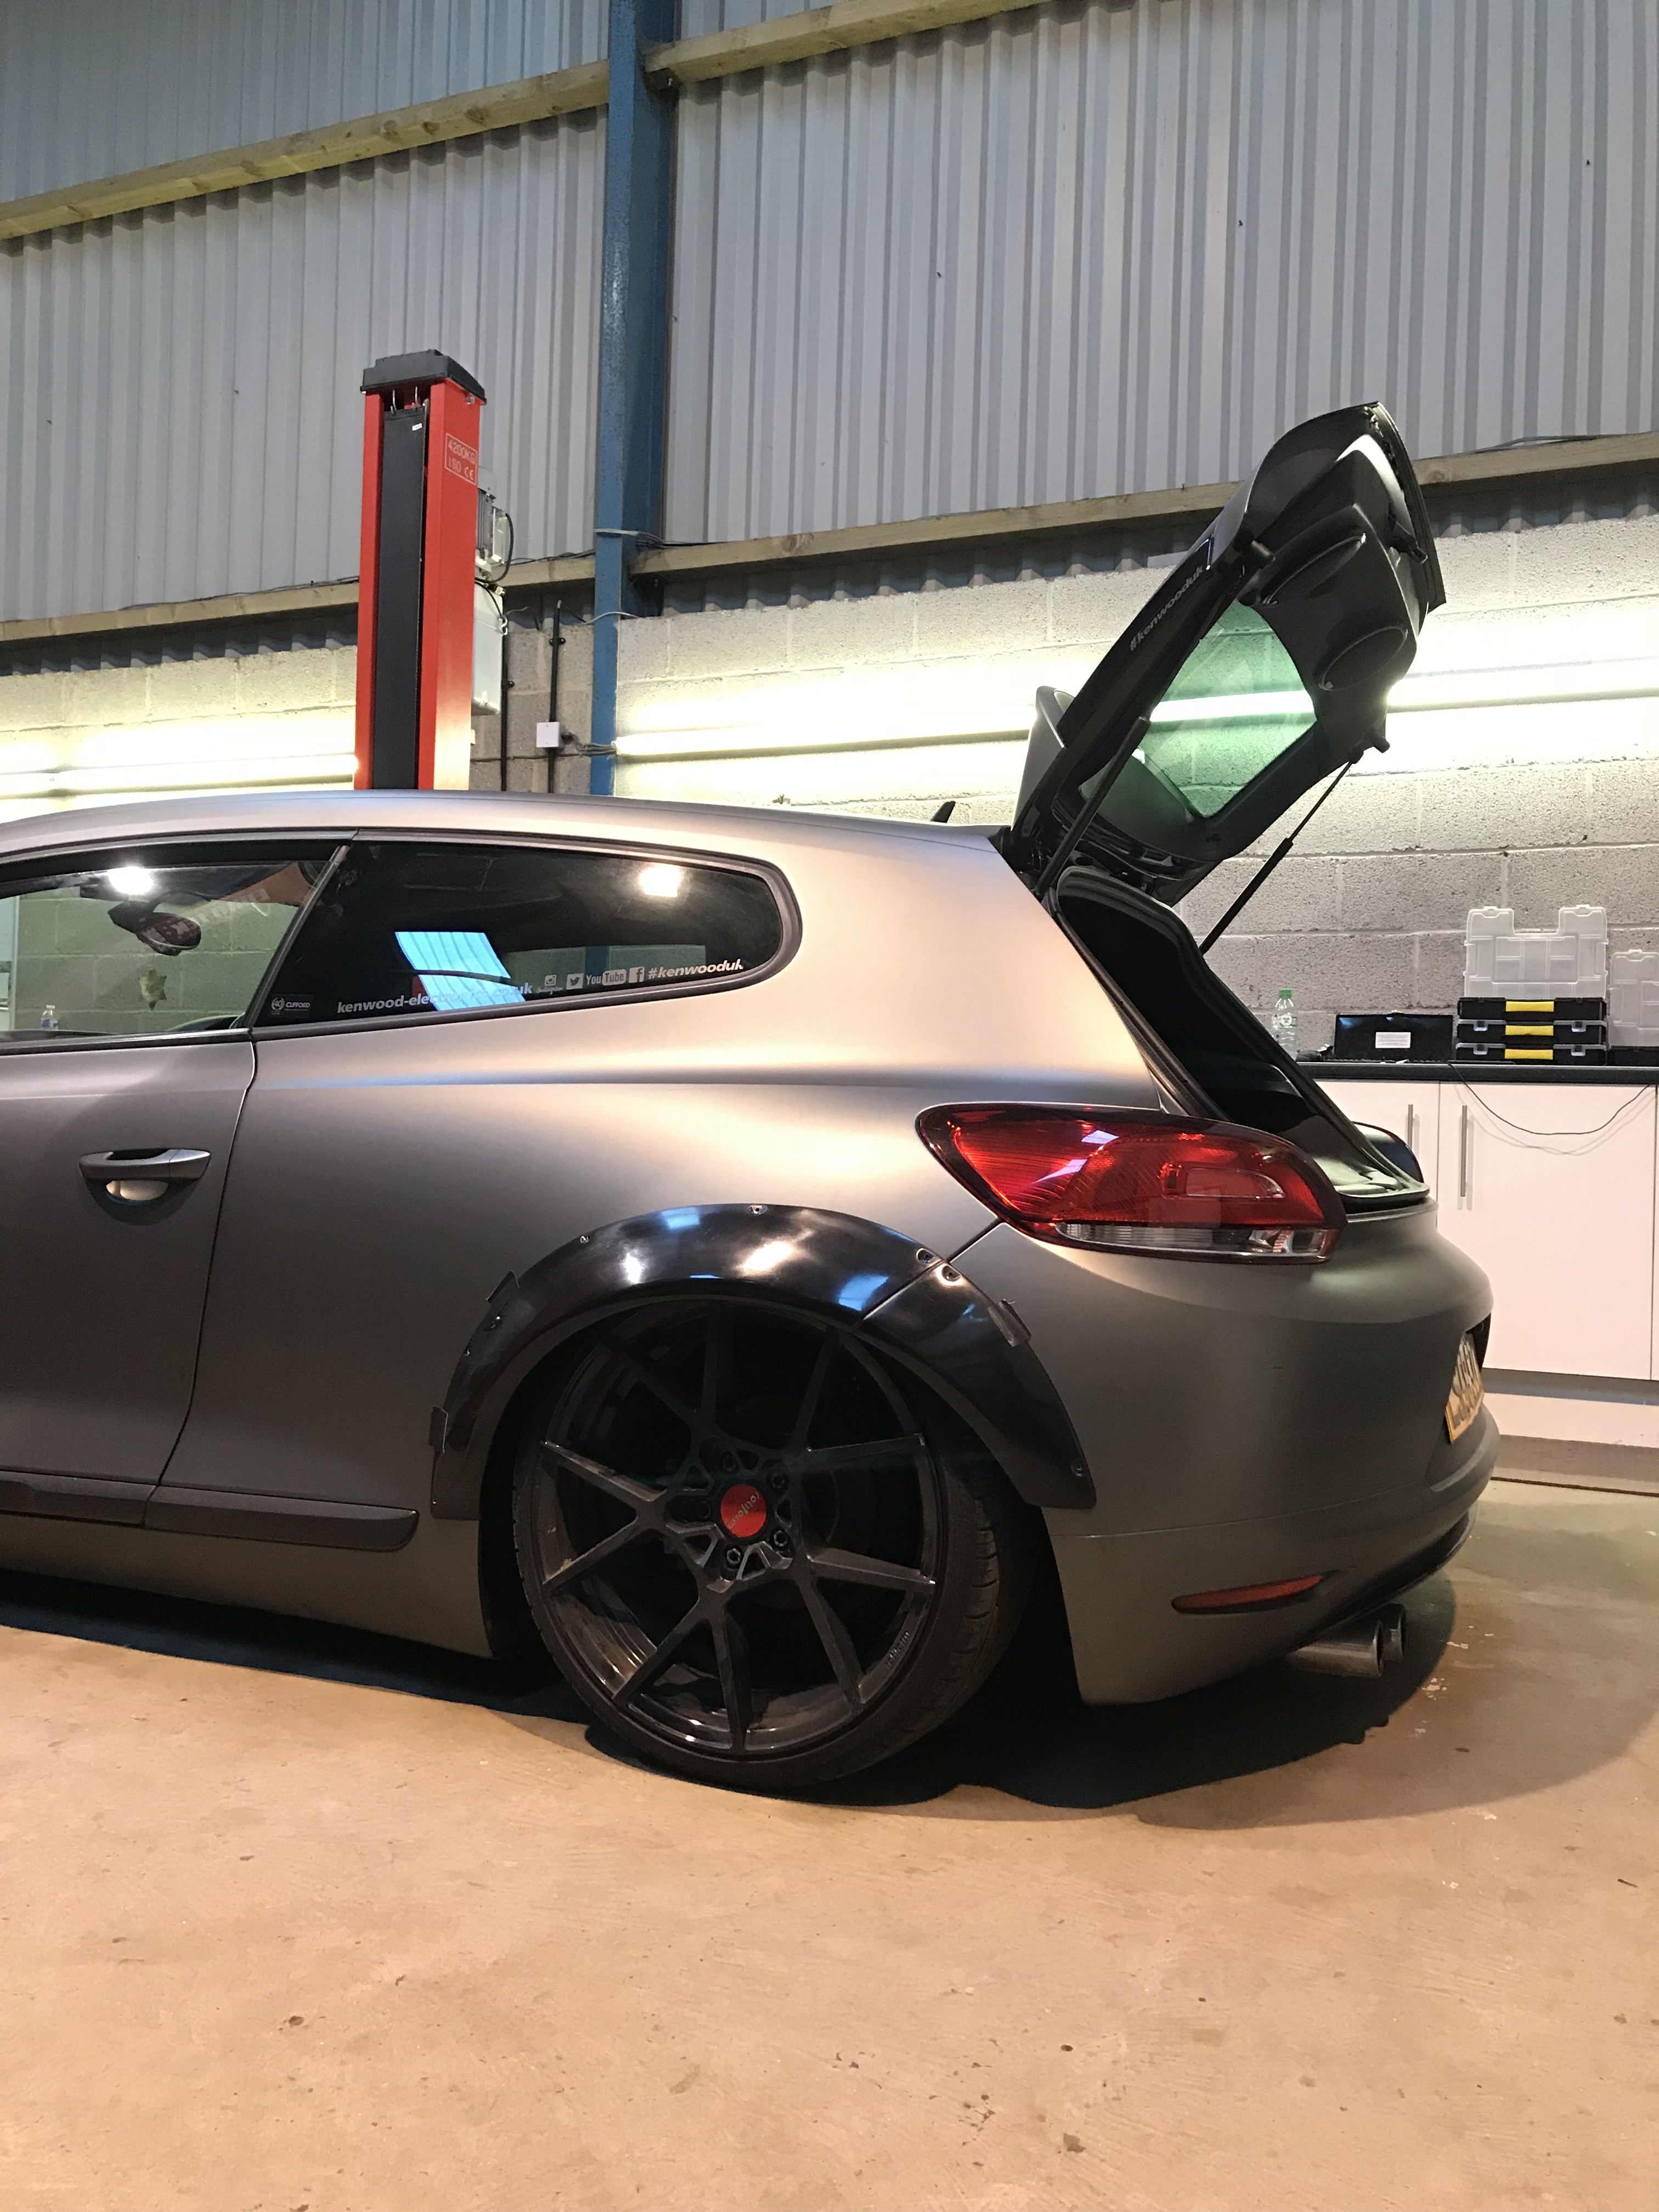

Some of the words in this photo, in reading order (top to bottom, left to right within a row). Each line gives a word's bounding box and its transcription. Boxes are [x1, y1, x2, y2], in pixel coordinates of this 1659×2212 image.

[448, 439, 475, 464] 4200KG
[449, 456, 461, 473] ISO
[1129, 565, 1204, 651] #kenwooduk
[648, 958, 744, 979] #kenwooduk
